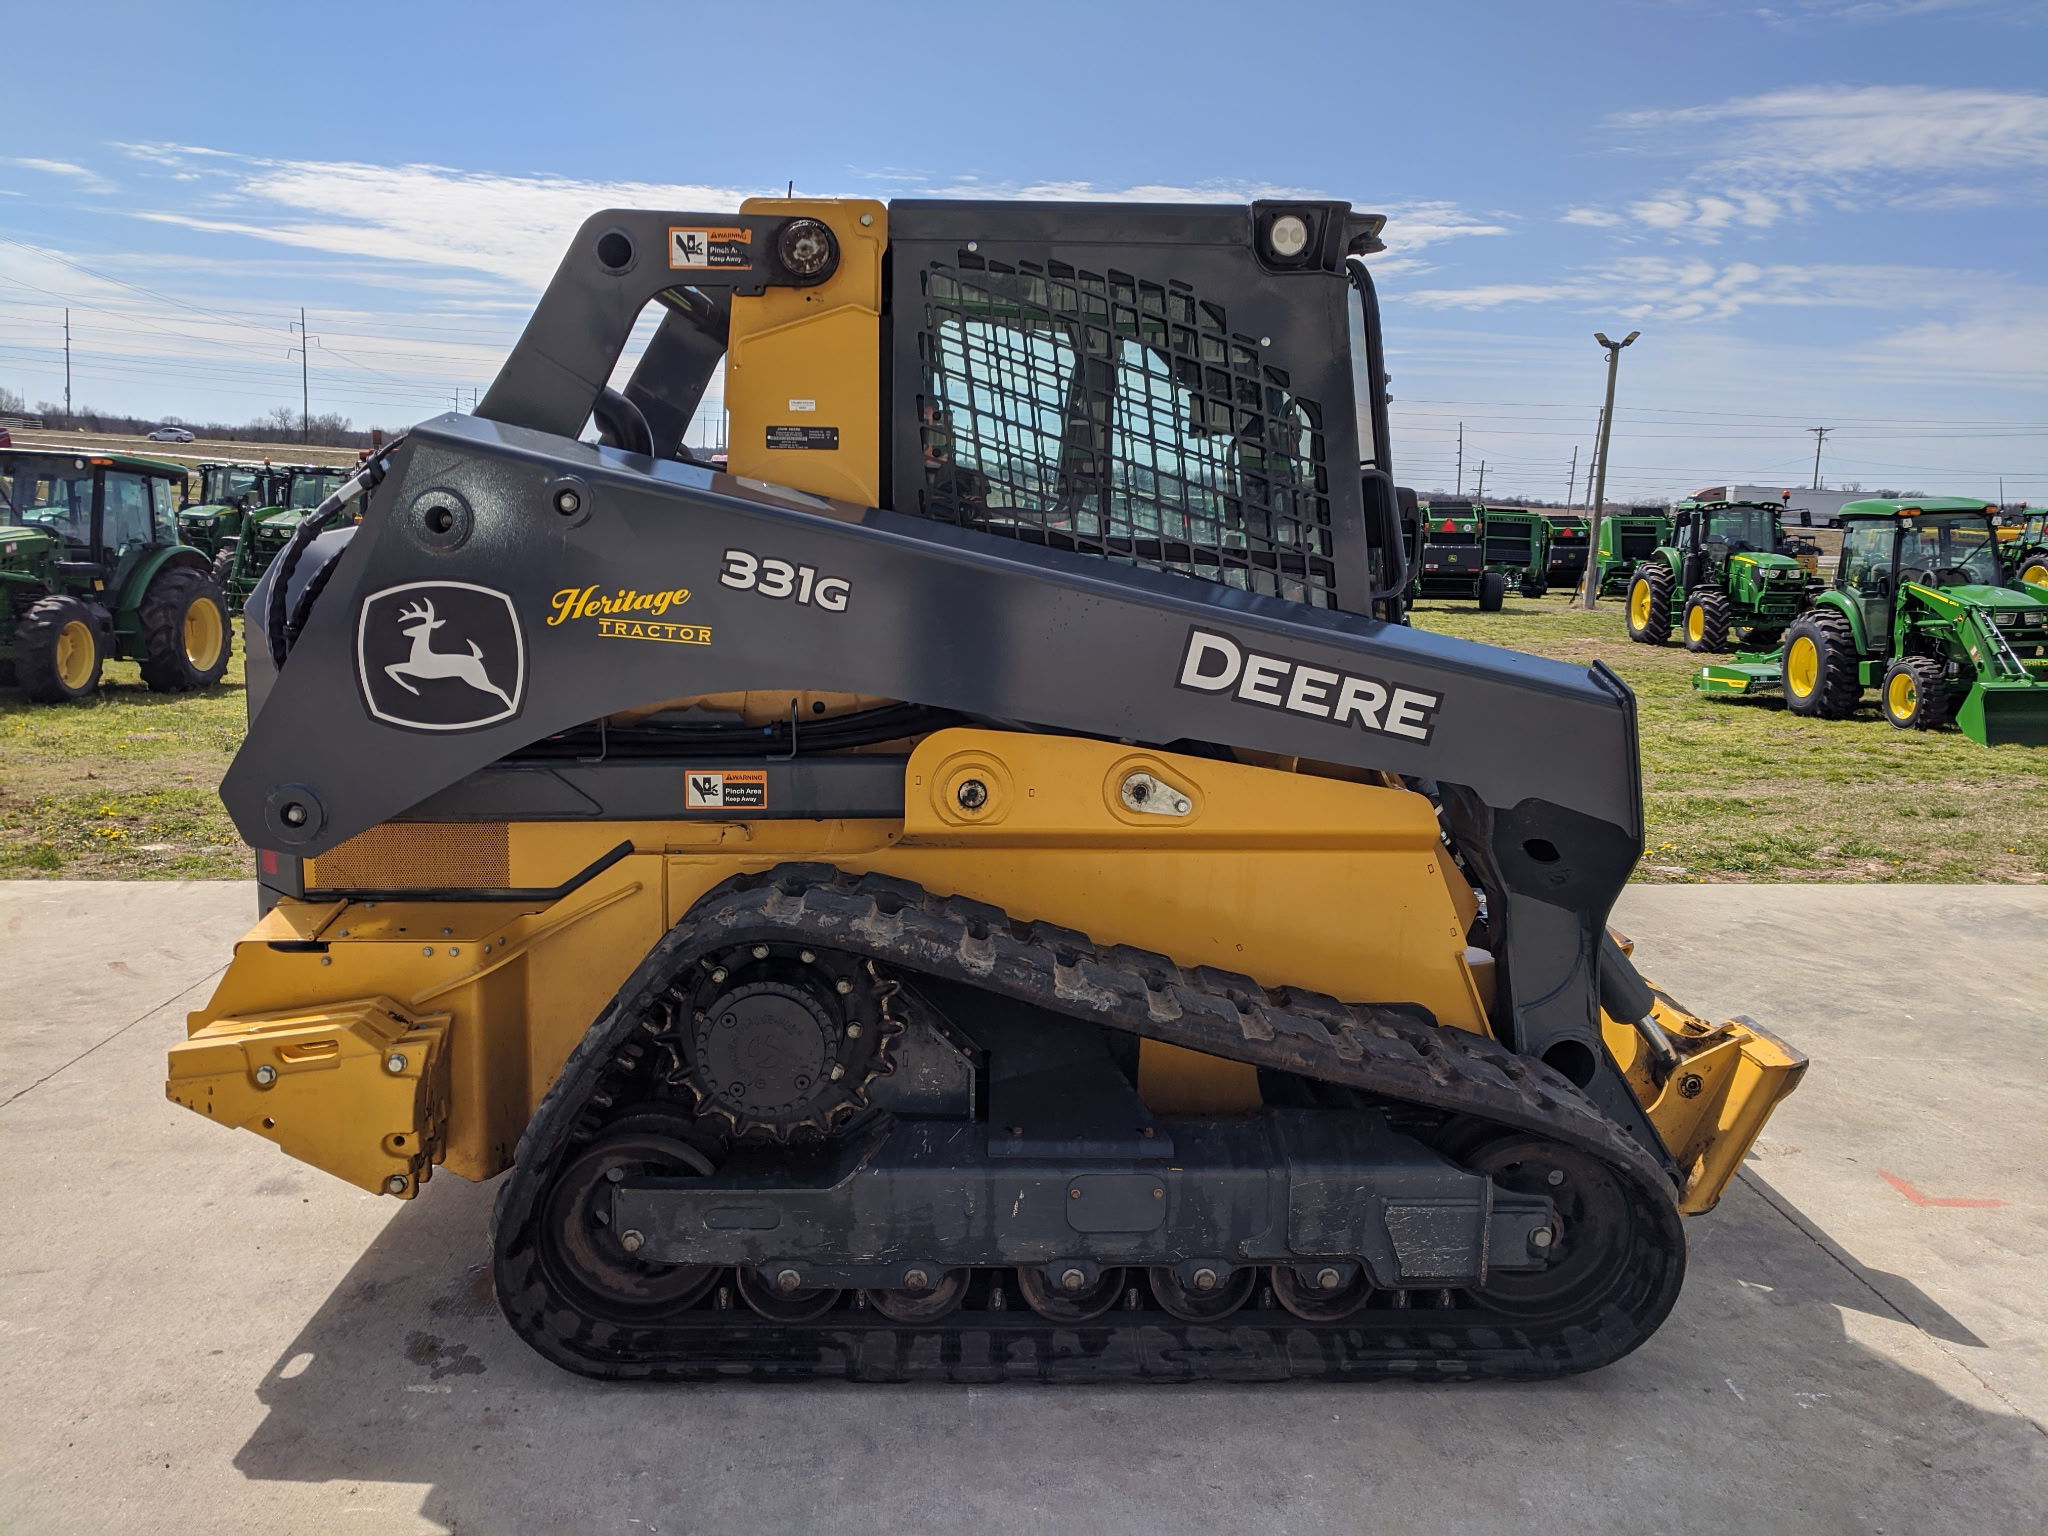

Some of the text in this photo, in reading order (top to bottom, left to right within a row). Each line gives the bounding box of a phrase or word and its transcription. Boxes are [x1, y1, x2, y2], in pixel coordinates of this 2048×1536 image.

[710, 246, 729, 254] Pinch
[716, 232, 747, 240] WARNING
[719, 550, 850, 612] 331G
[546, 584, 691, 626] Heritage
[599, 621, 712, 642] TRACTOR
[1180, 631, 1437, 740] DEERE
